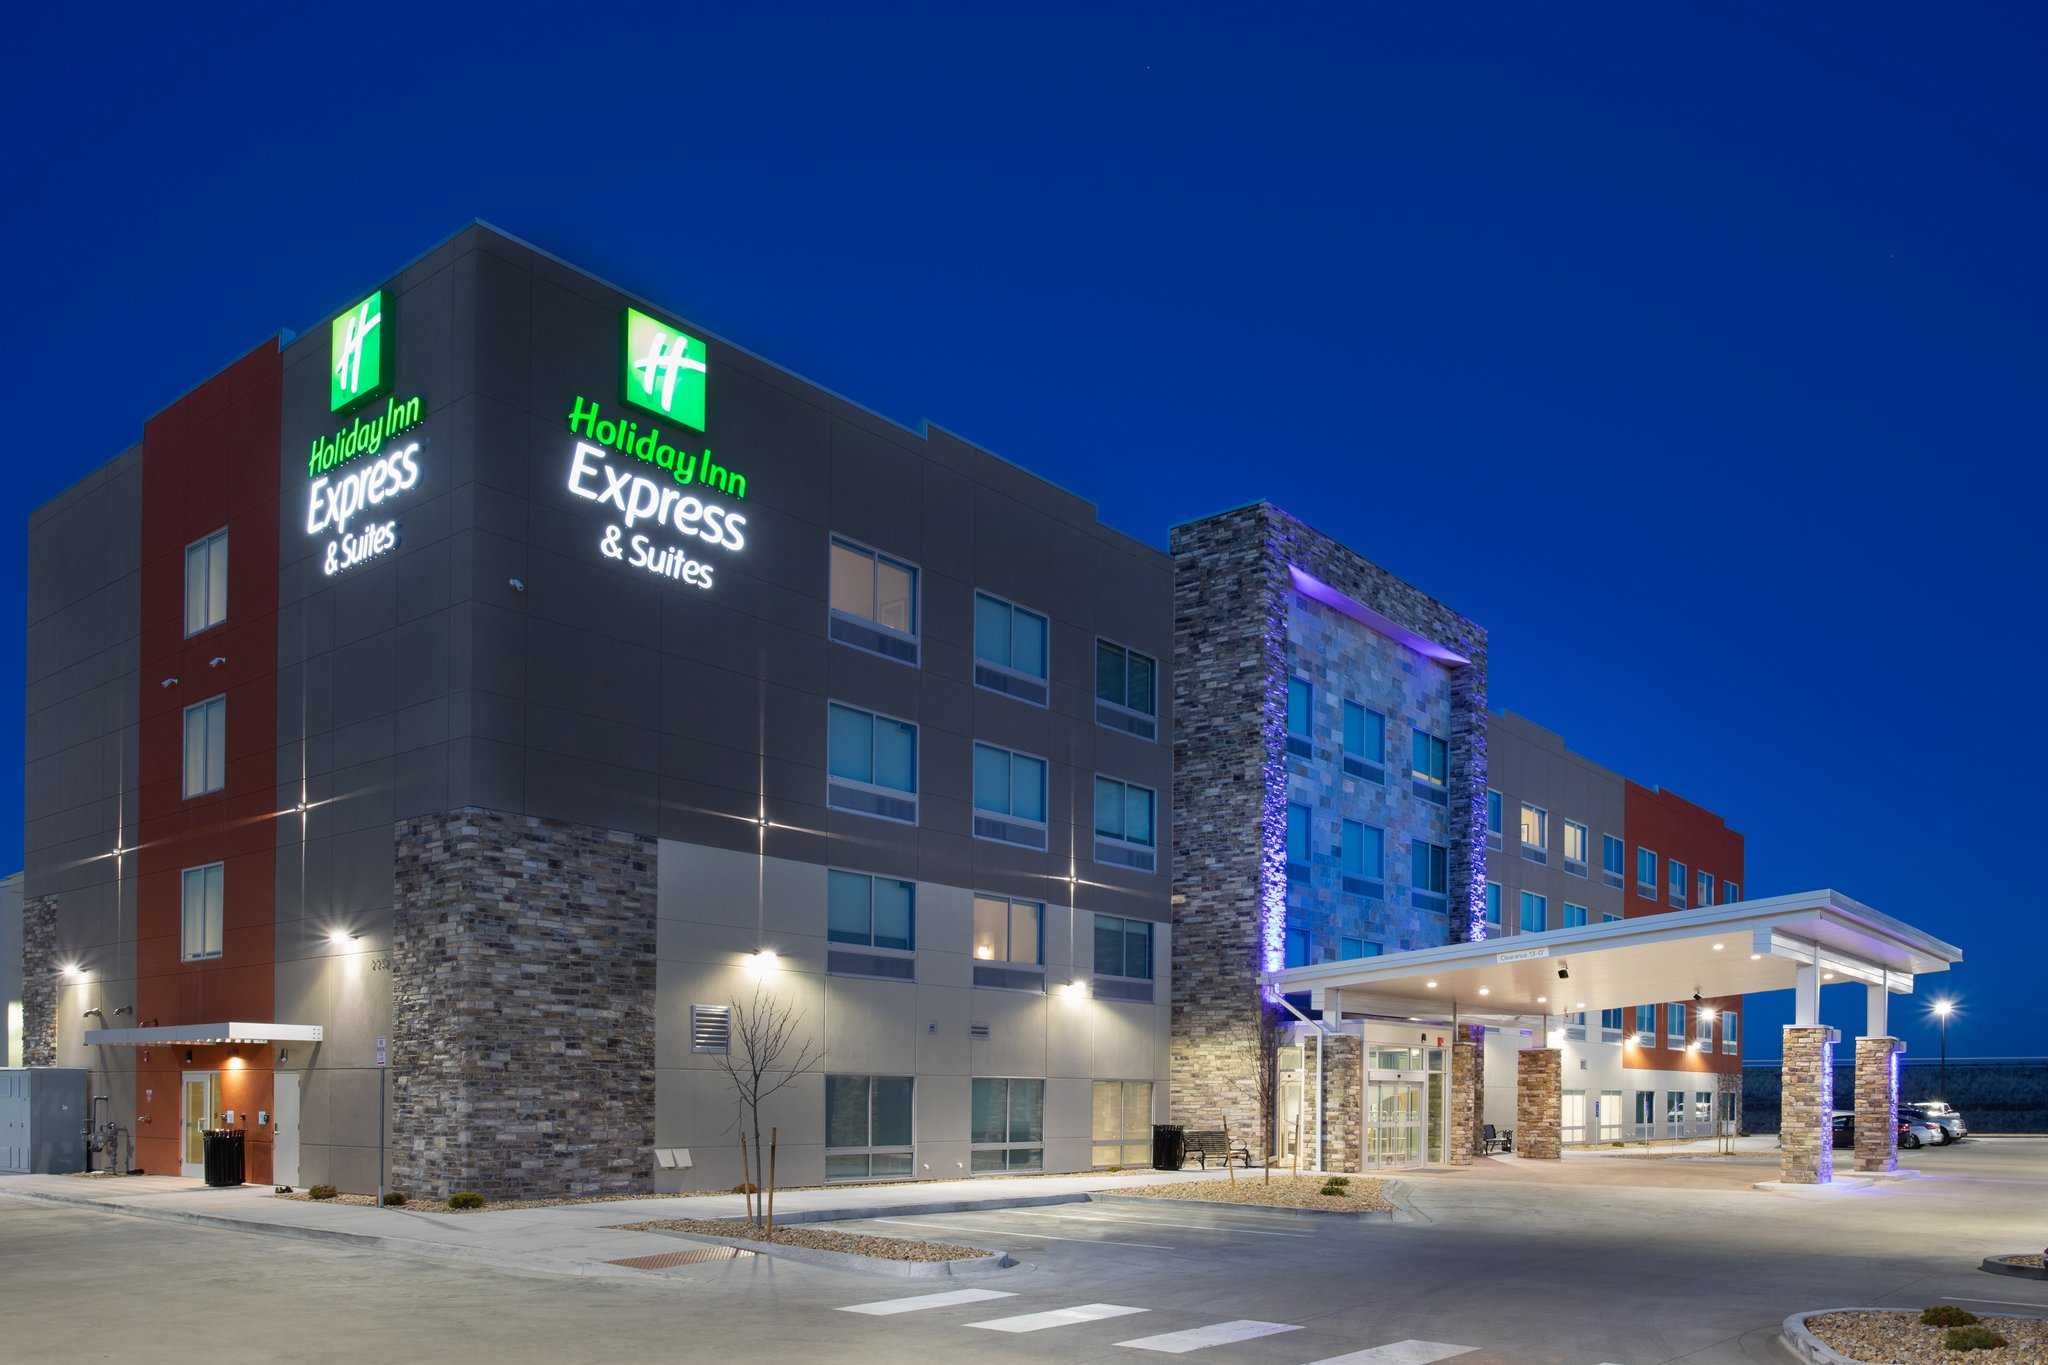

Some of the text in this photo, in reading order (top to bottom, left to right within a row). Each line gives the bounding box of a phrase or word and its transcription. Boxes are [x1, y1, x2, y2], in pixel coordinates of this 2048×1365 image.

[308, 396, 420, 478] Holiday Inn
[568, 395, 747, 498] Holiday Inn
[306, 442, 420, 534] Express
[567, 441, 747, 551] Express
[323, 520, 396, 576] & Suites
[599, 524, 714, 589] & Suites
